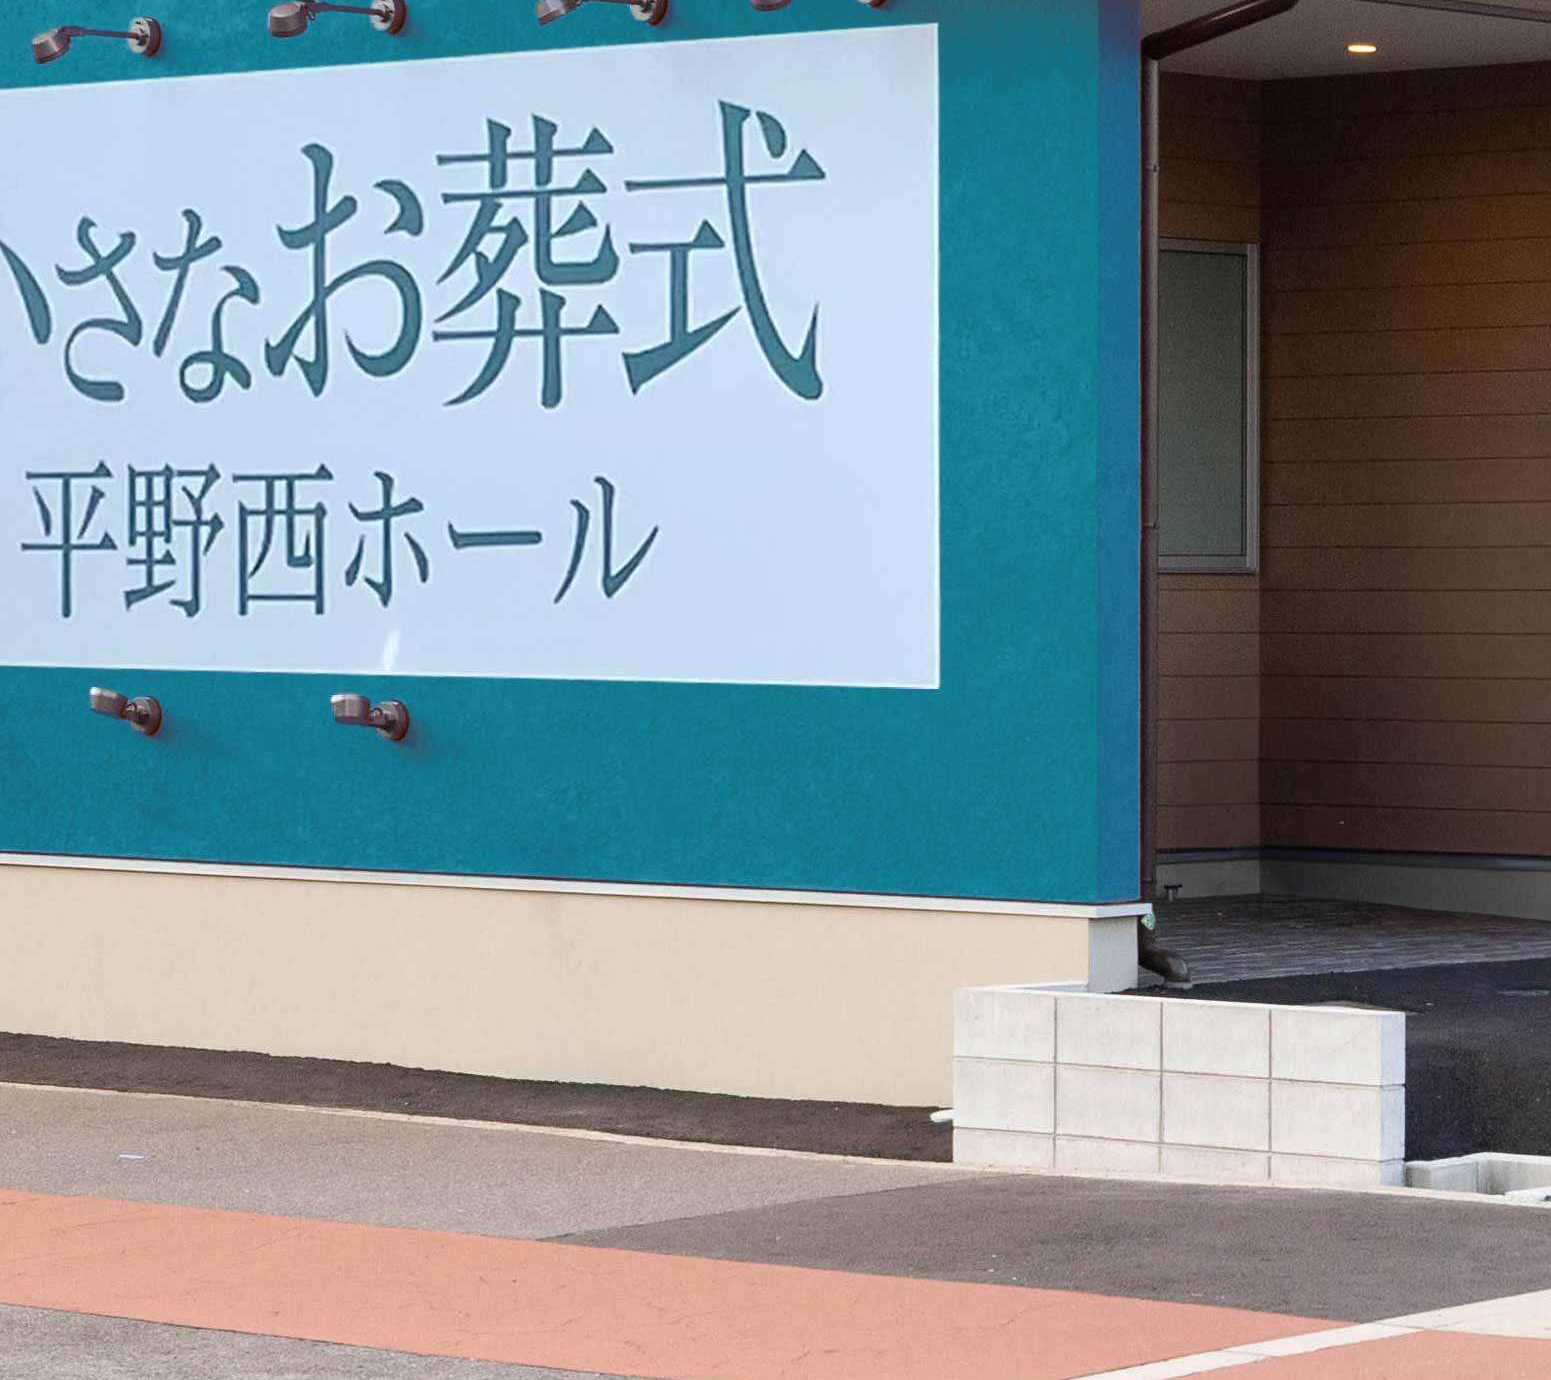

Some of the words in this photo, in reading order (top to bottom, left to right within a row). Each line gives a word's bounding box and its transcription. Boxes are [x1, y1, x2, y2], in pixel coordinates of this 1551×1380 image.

[21, 460, 659, 619] 平野西ホール
